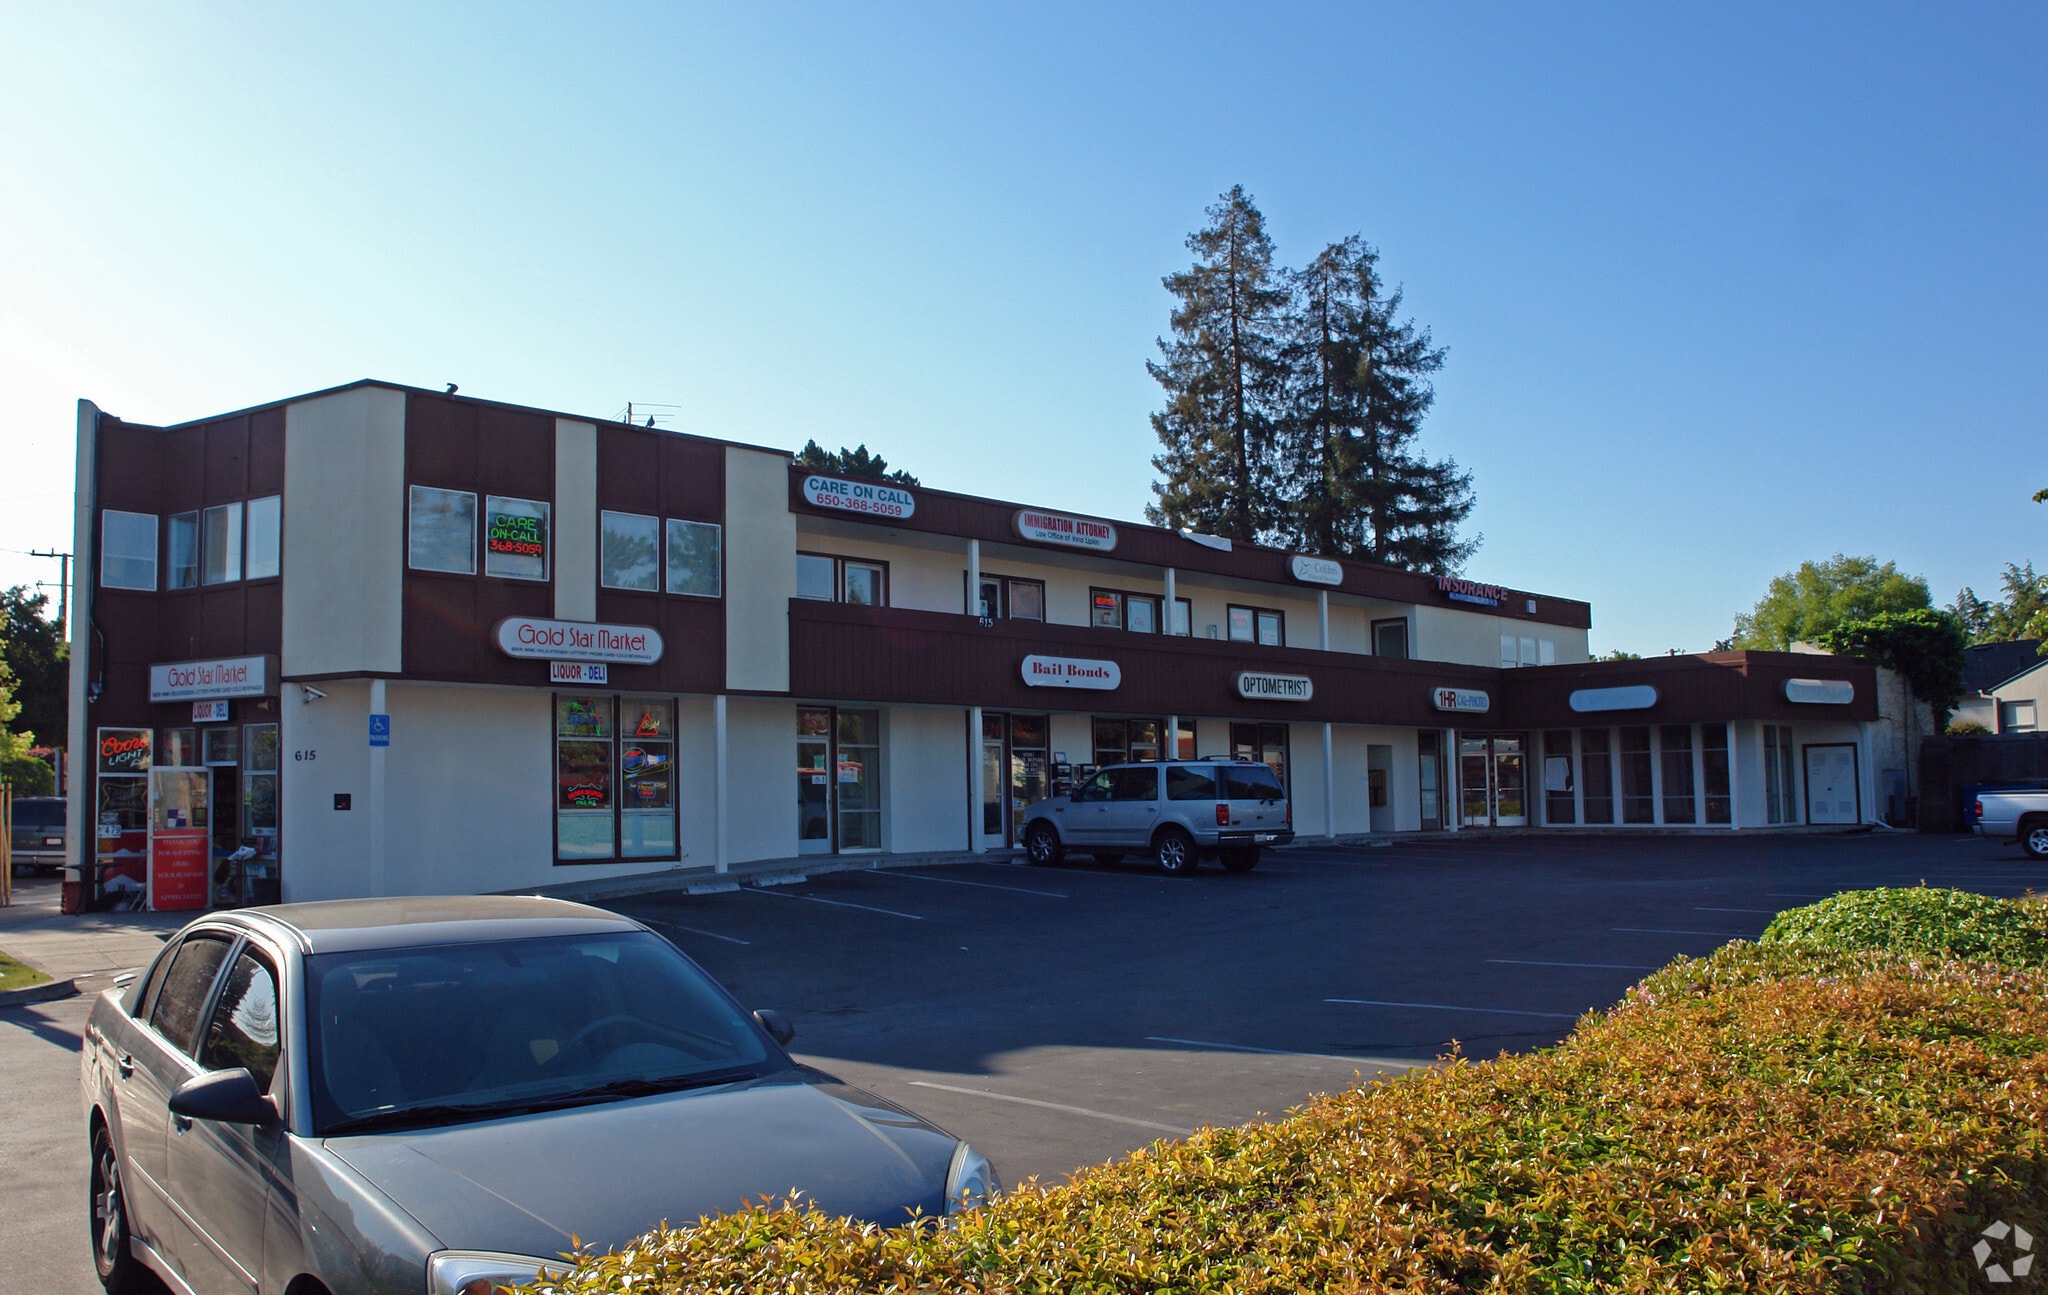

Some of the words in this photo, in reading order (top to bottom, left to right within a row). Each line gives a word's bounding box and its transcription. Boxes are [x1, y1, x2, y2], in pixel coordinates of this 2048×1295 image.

[809, 478, 848, 495] CARE
[853, 485, 873, 499] ON
[878, 489, 912, 505] CALL
[816, 493, 902, 516] 650-368-5059
[495, 514, 537, 531] CARE
[1024, 513, 1073, 533] IMMIGRATION
[1076, 522, 1110, 539] ATTORNEY
[490, 527, 542, 544] ON-CALL
[1047, 531, 1063, 540] Office
[490, 540, 543, 554] 368-5059
[1438, 576, 1508, 601] INSURANCE
[979, 617, 994, 628] 615
[518, 624, 564, 646] Gold
[569, 627, 595, 648] Star
[597, 629, 647, 651] Market
[168, 668, 195, 687] Gold
[198, 666, 213, 685] Star
[216, 663, 247, 685] Market
[552, 664, 582, 679] LIQUOR
[588, 665, 606, 680] DELI
[1032, 662, 1062, 676] Bail
[1067, 664, 1110, 679] Bonds
[1243, 676, 1307, 696] OPTOMETRIST
[1439, 690, 1457, 708] 1HR
[194, 703, 212, 718] LIQUOR
[216, 703, 227, 717] DELI
[101, 736, 148, 757] Coors
[294, 750, 317, 761] 615
[109, 748, 143, 766] LIGHT
